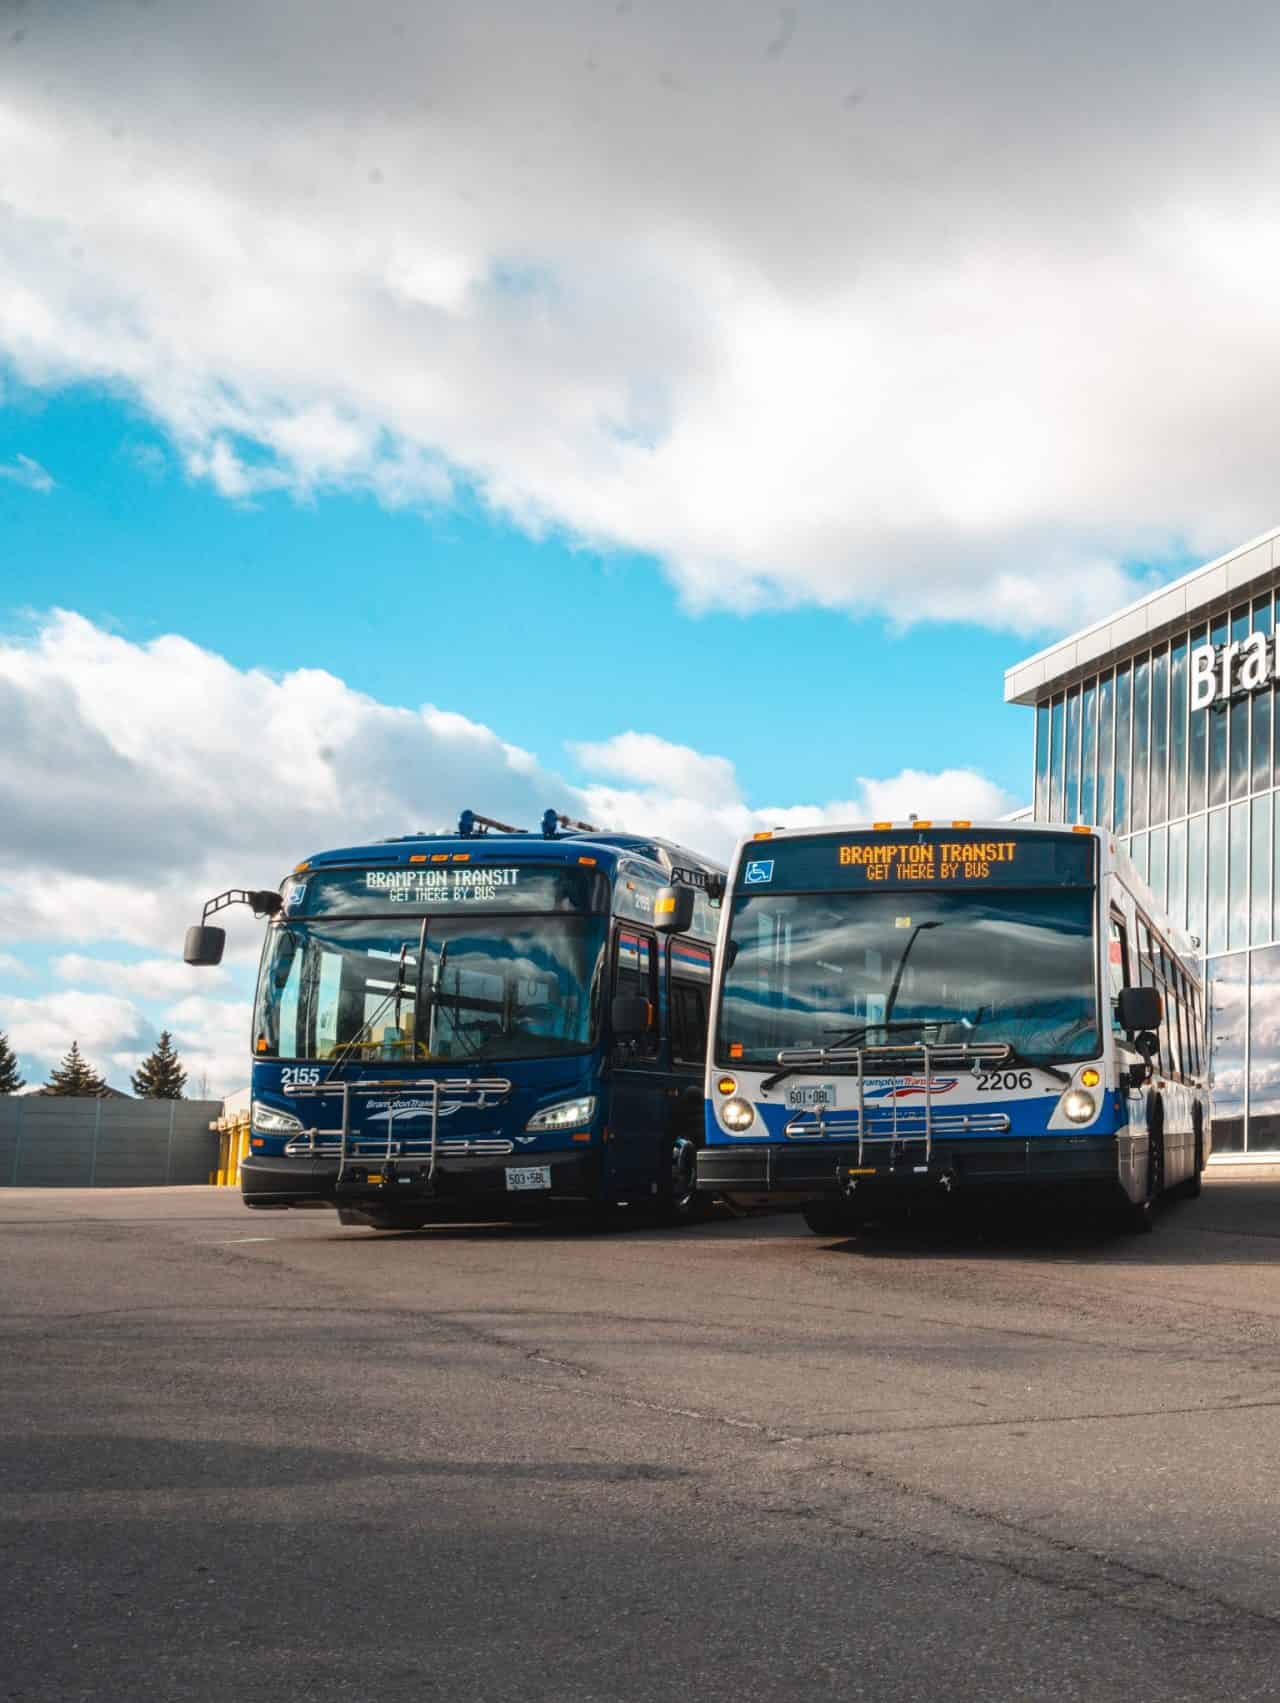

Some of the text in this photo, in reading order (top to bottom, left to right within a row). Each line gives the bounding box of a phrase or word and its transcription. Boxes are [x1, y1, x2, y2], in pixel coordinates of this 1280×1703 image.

[840, 842, 1016, 864] BRAMPTON TRANSIT
[366, 869, 520, 888] BRAMPTON TRANSIT
[866, 862, 990, 880] GET THERE BY BUS
[390, 886, 496, 902] GET THERE BY BUS
[280, 1068, 320, 1084] 2155
[976, 1072, 1033, 1091] 2206
